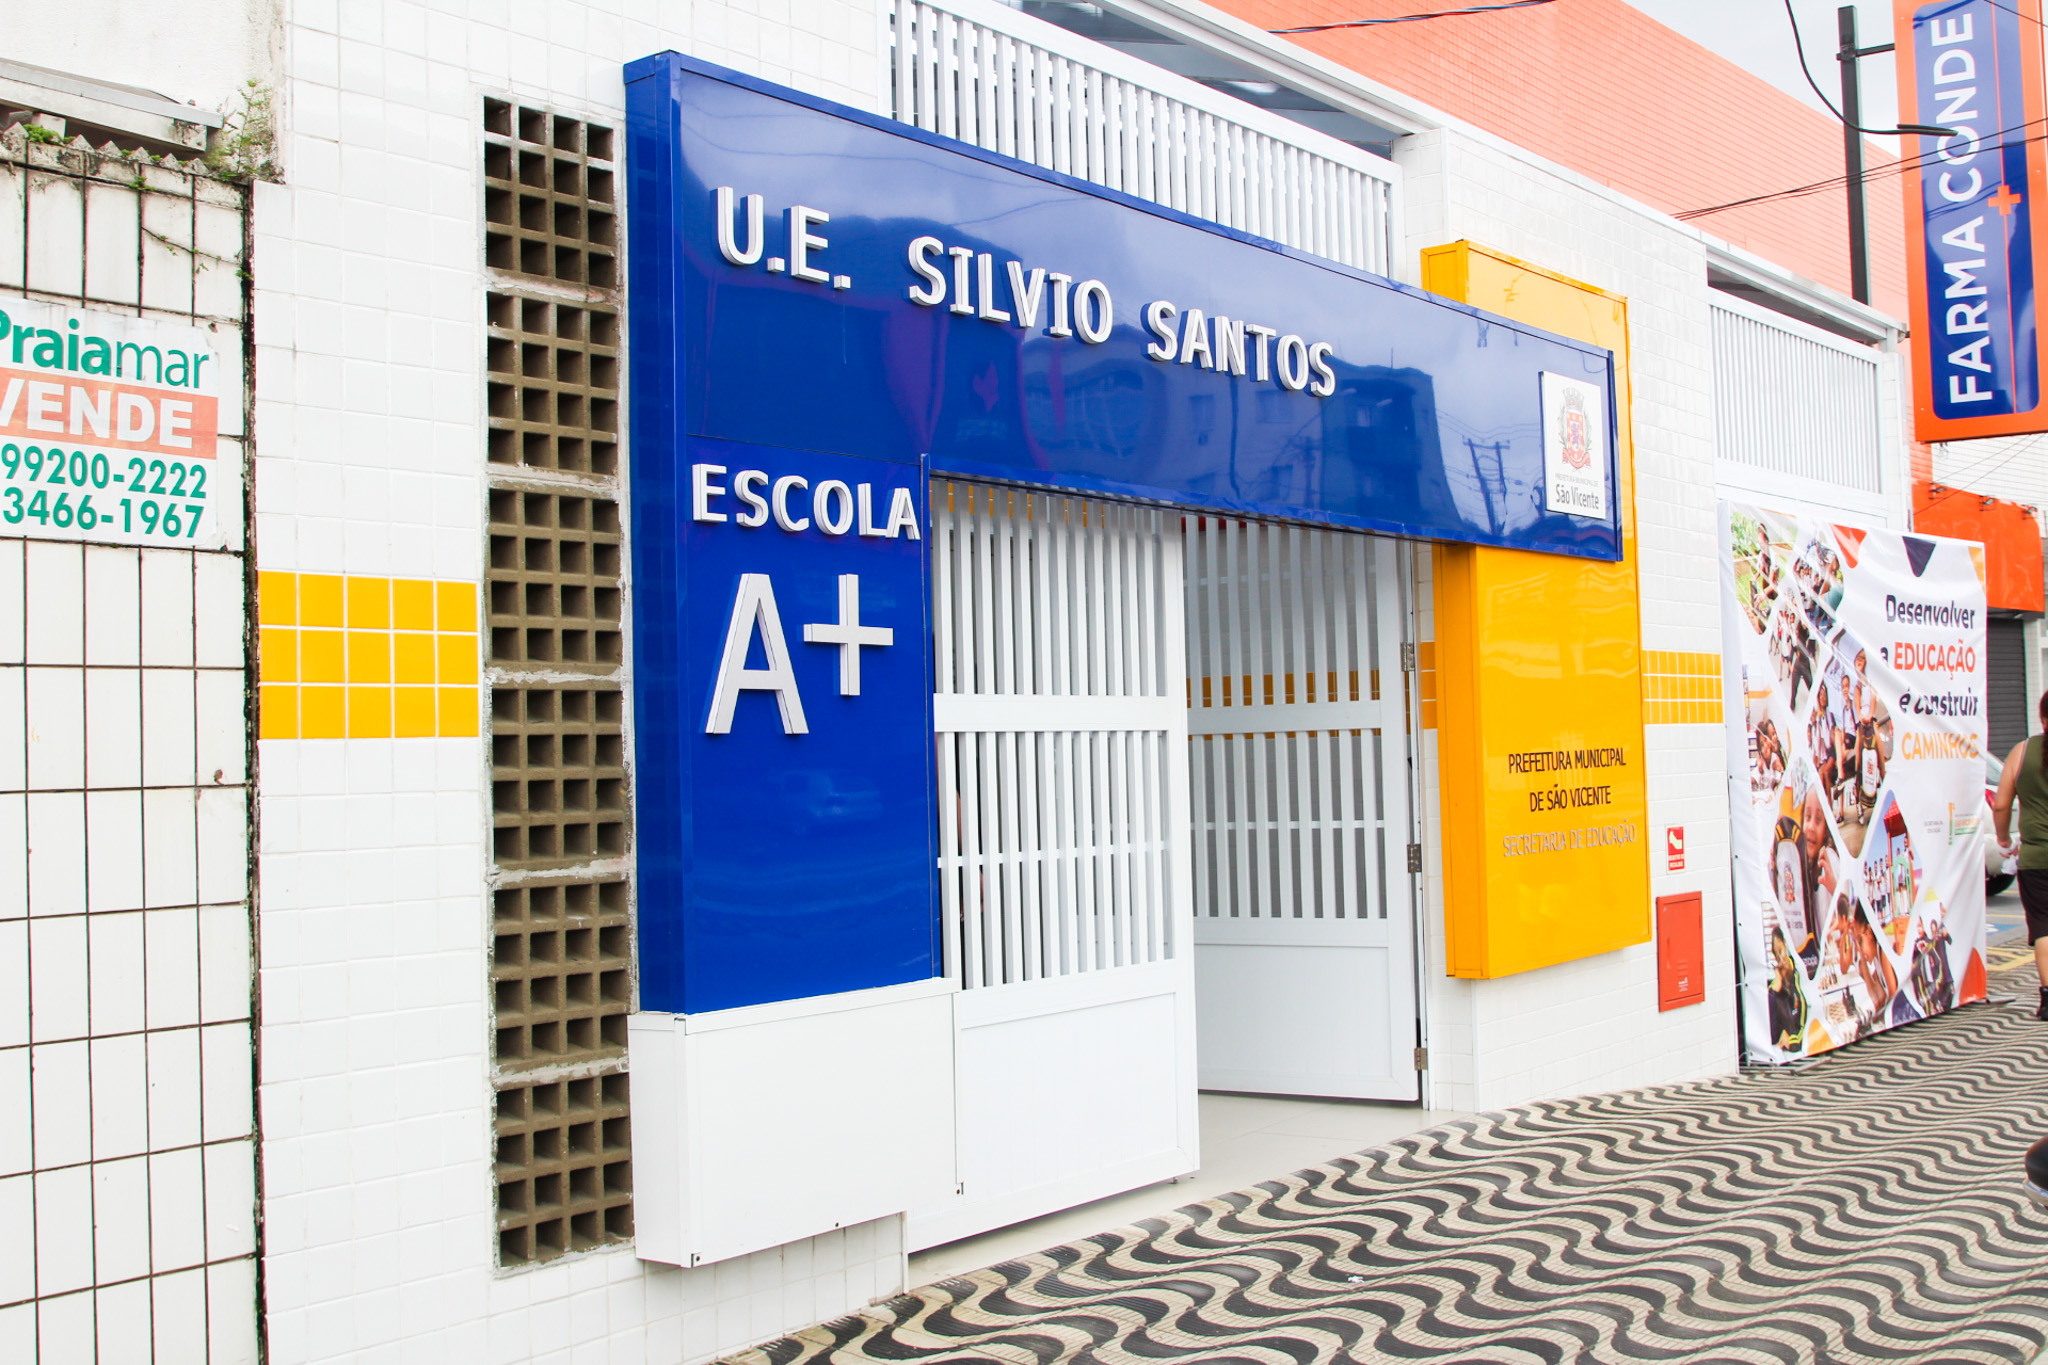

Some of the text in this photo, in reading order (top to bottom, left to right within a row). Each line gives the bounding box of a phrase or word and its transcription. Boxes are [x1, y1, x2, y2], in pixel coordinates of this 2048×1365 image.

[1930, 13, 1993, 405] FARMA CONDE
[717, 185, 1336, 397] U.E. SILVIO SANTOS
[1, 443, 207, 499] 99200-2222
[3, 486, 205, 538] 3466-1967
[691, 463, 921, 540] ESCOLA
[1555, 483, 1600, 510] São Vicente
[1886, 594, 1976, 629] Desenvolver
[1880, 639, 1976, 680] a EDUCAÇÃO
[1508, 747, 1627, 774] PREFEITURA MUNICIPAL
[1902, 732, 1980, 760] CAMINHOS
[1529, 783, 1611, 812] DE SÃO VICENTE
[1503, 818, 1637, 857] SECRETARIA DE EDUCAÇÃO
